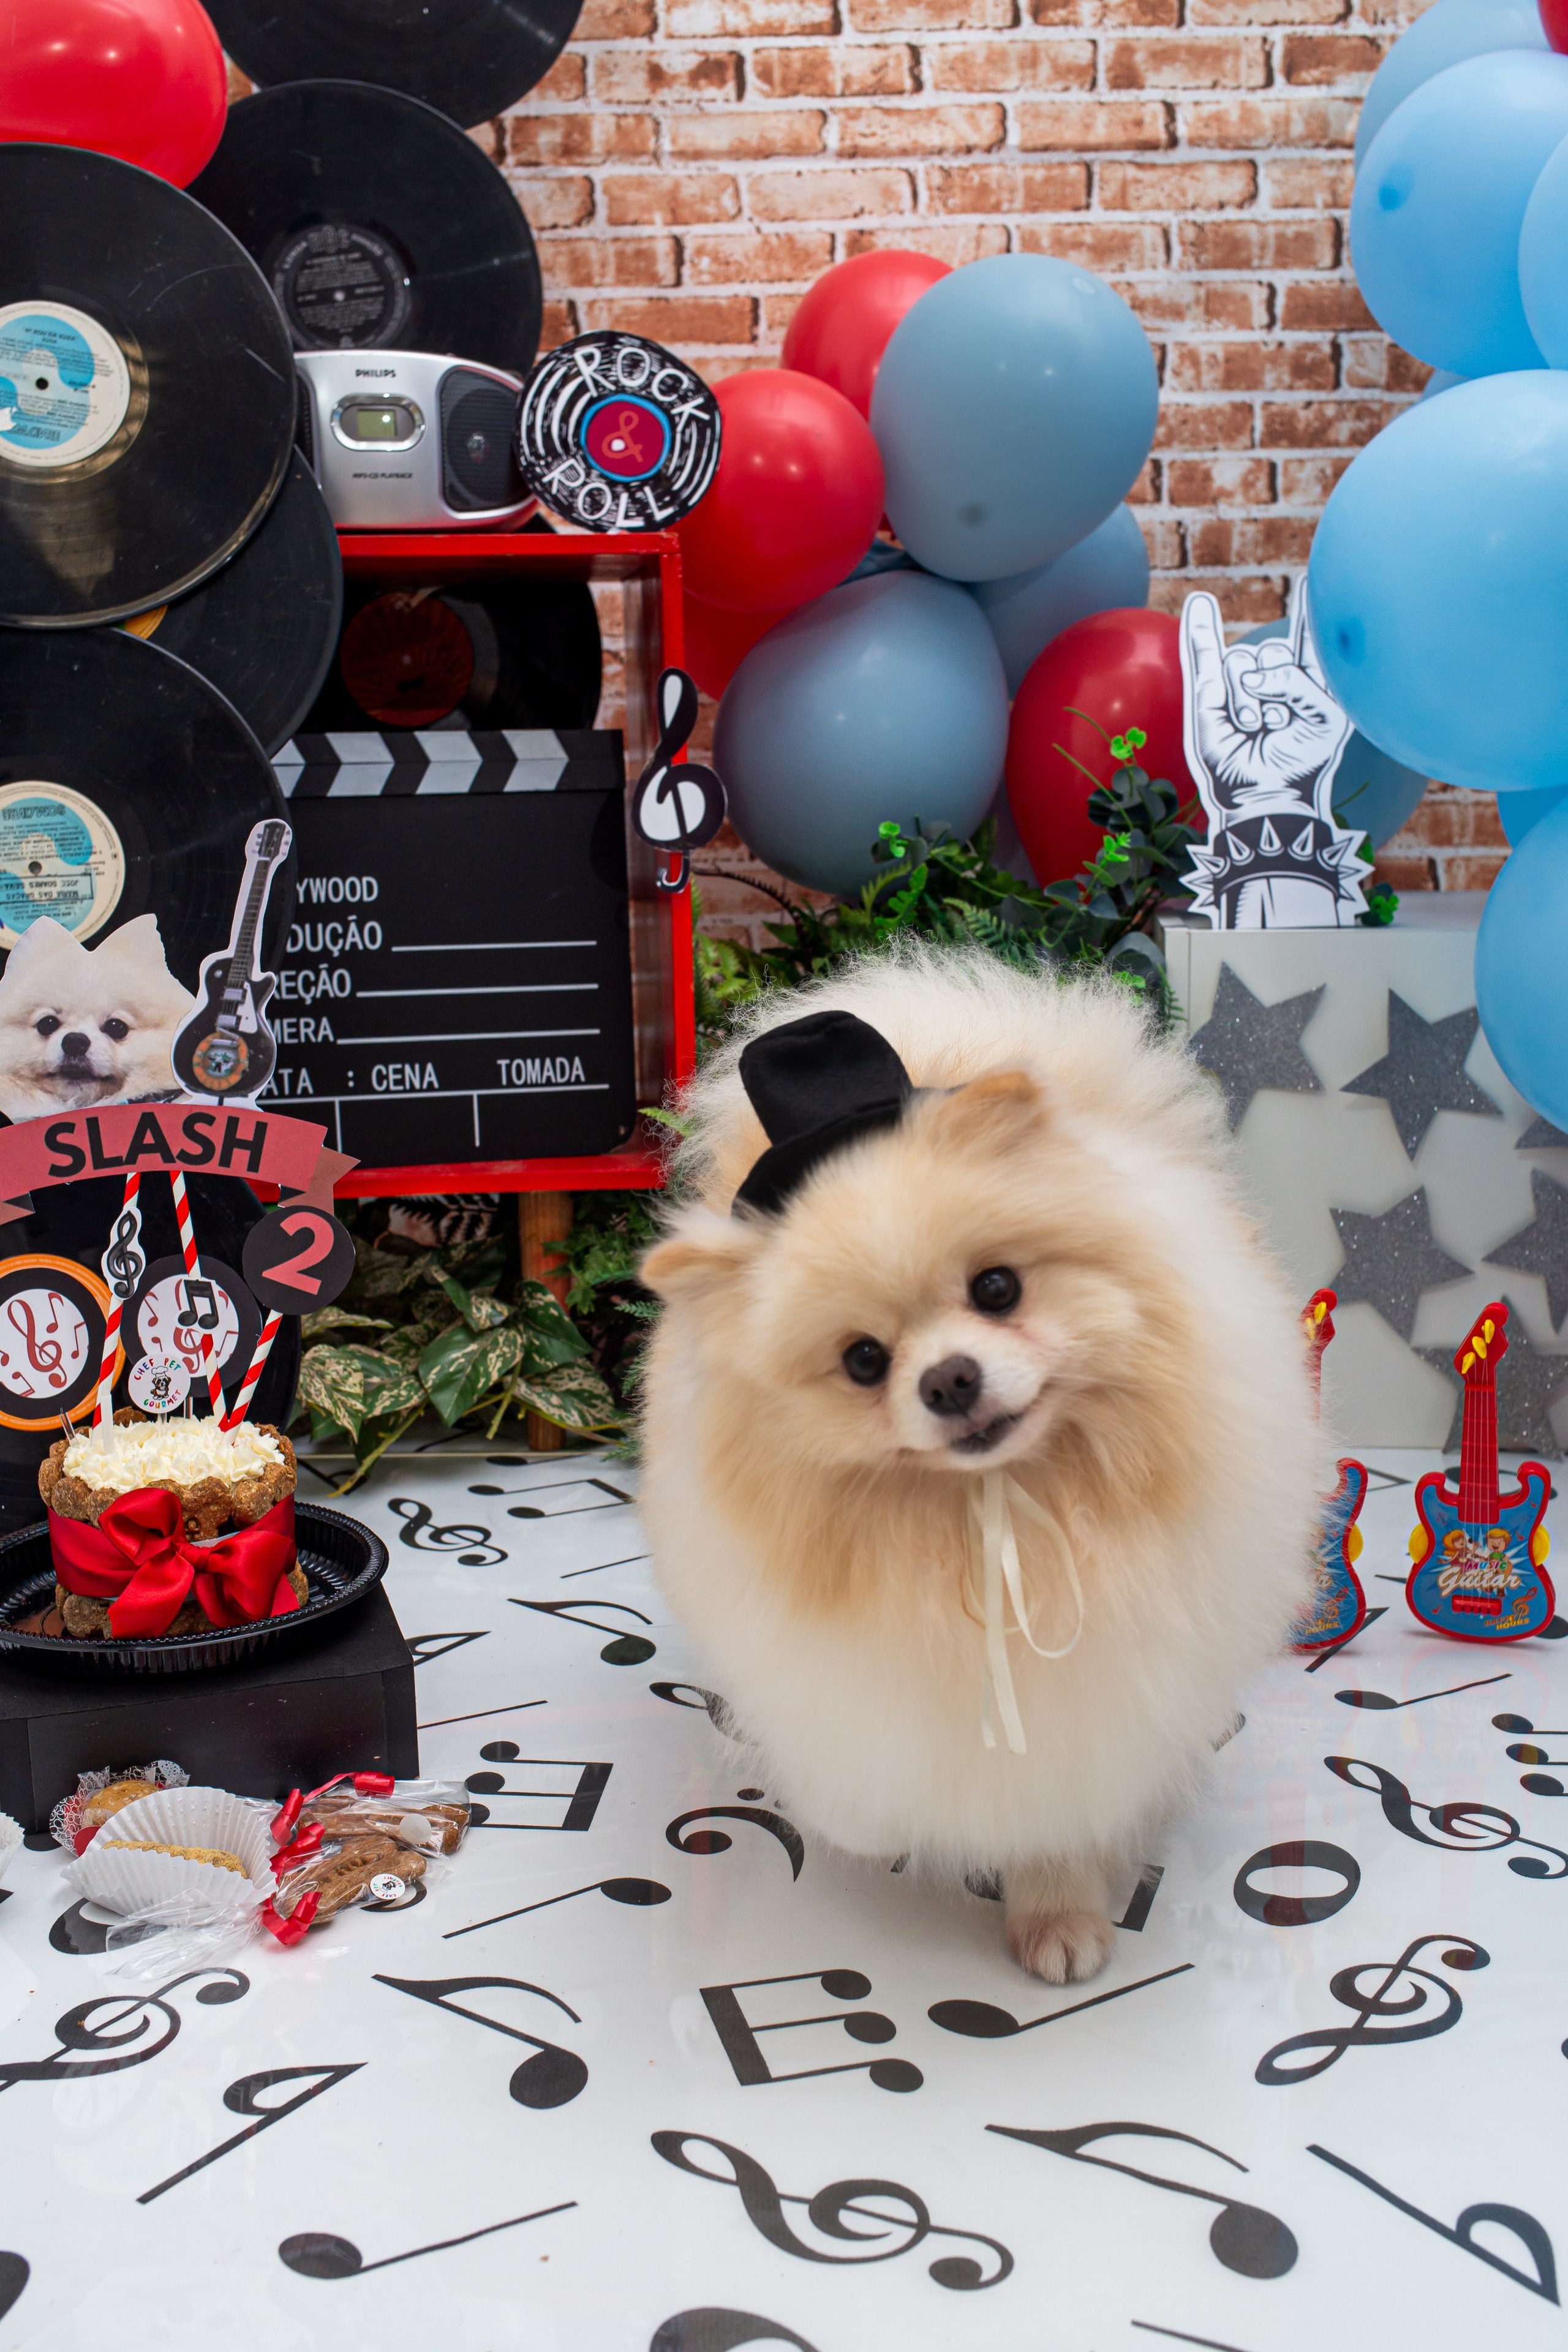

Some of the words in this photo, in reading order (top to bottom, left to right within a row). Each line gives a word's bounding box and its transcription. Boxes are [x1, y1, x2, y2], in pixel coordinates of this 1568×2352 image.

[355, 369, 396, 377] PHILIPS
[572, 347, 710, 432] ROCK
[541, 459, 675, 528] ROLL
[285, 914, 383, 958] DUÇÃO
[371, 1061, 439, 1091] CENA
[496, 1056, 586, 1086] TOMADA
[43, 1111, 269, 1178] SLASH
[261, 1210, 335, 1296] 2
[134, 1358, 154, 1381] CHEF
[164, 1357, 182, 1371] PET
[143, 1389, 182, 1409] GOURMET
[1437, 1566, 1521, 1598] Guitar
[1465, 1561, 1509, 1570] MUSIC
[1496, 1617, 1530, 1630] HOURS
